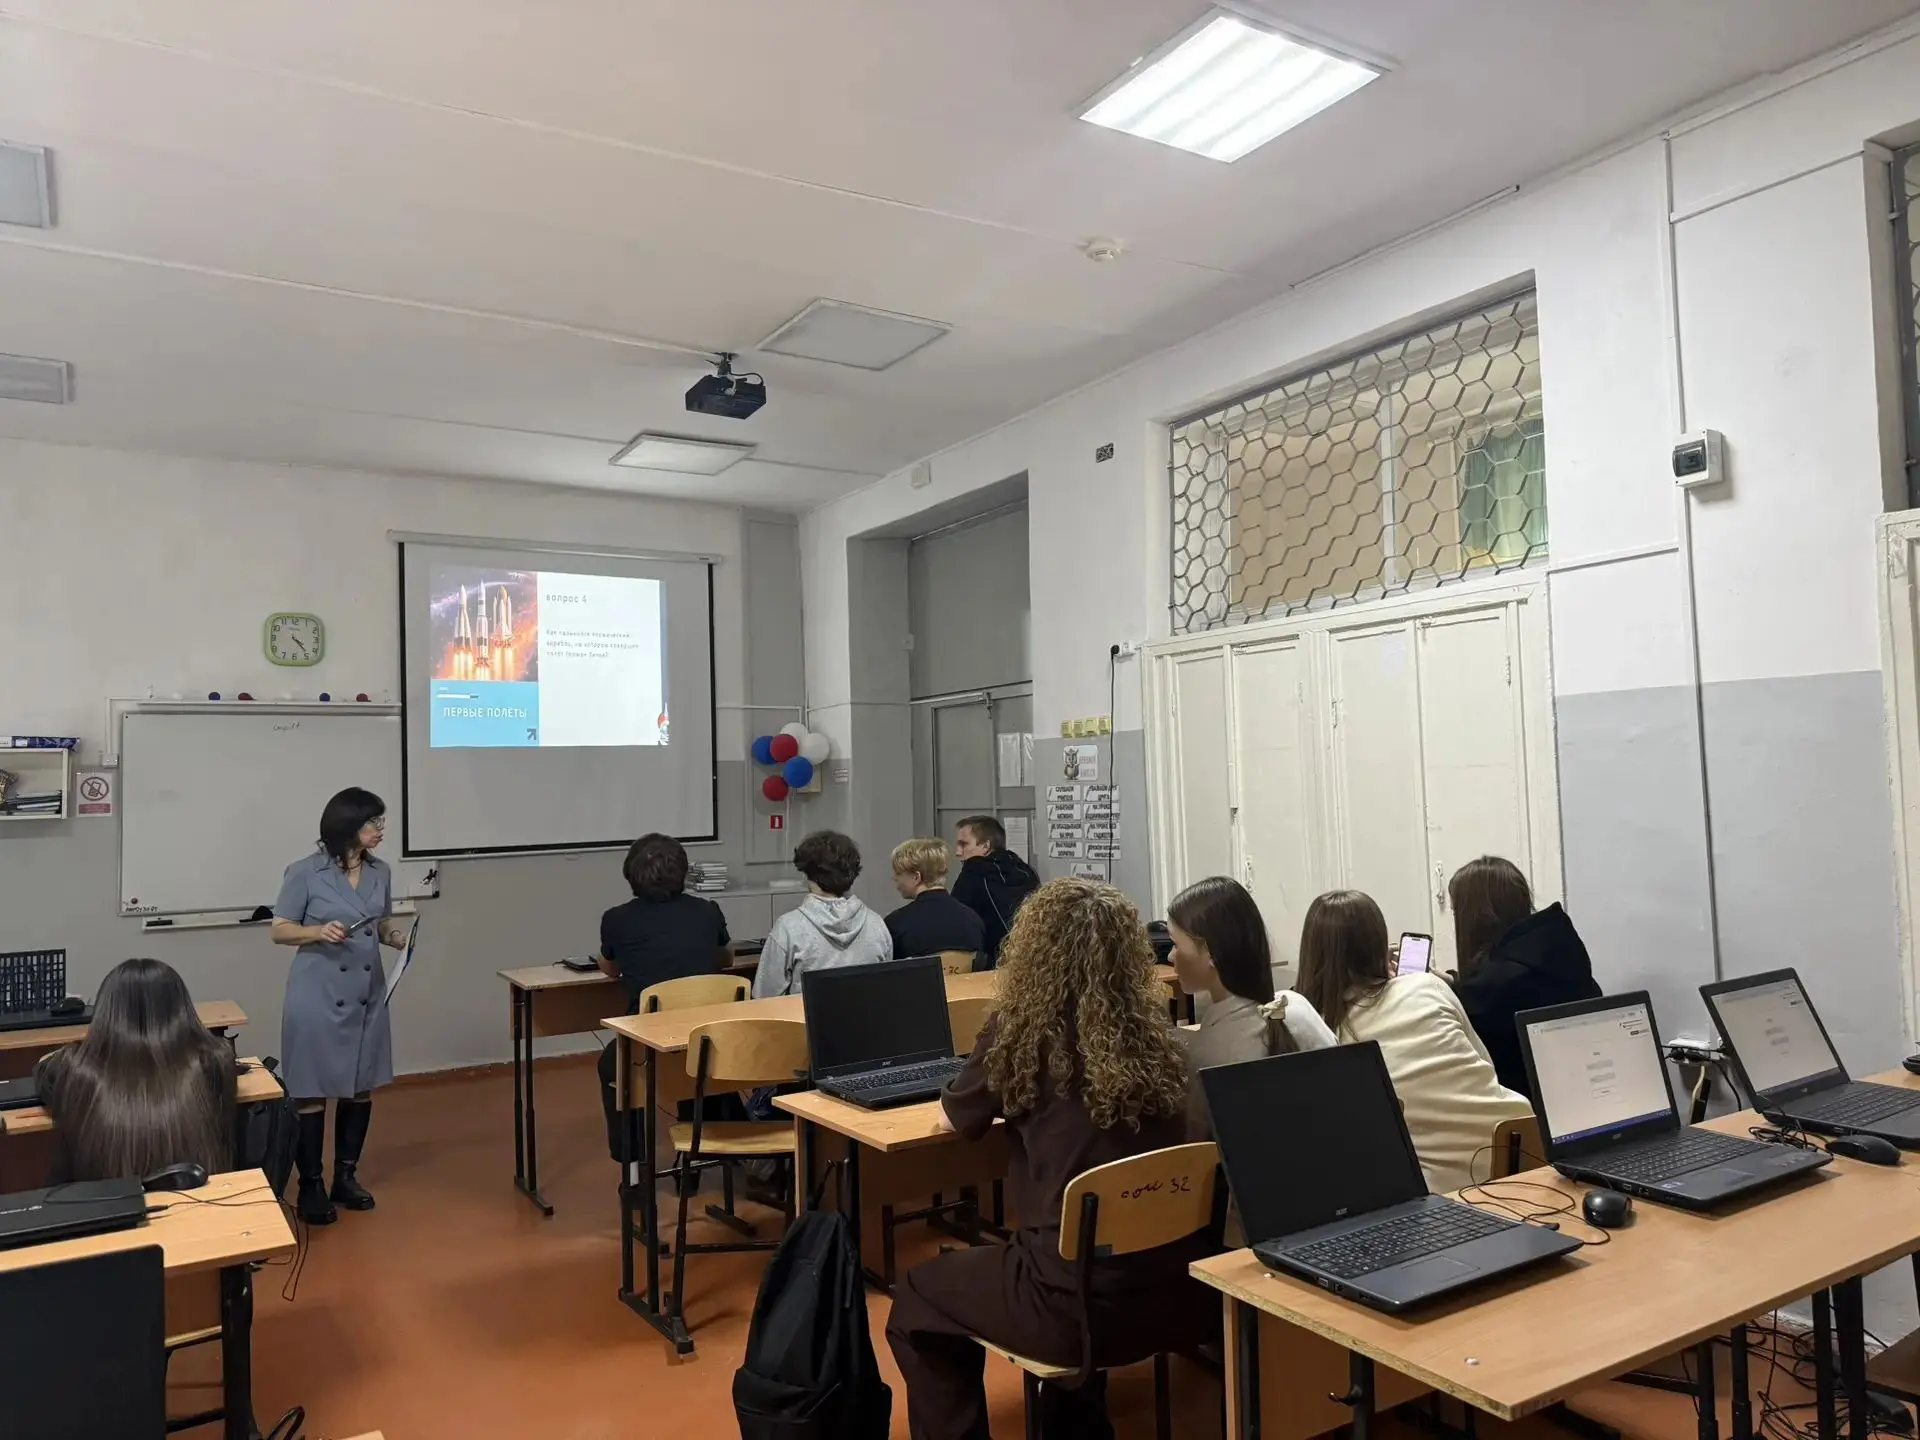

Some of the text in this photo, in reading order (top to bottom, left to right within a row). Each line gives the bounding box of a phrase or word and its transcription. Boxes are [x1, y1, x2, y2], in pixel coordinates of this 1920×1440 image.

[546, 593, 587, 603] вопрос 4
[443, 707, 484, 718] ПЕРВЫЕ
[1170, 1176, 1191, 1194] 32
